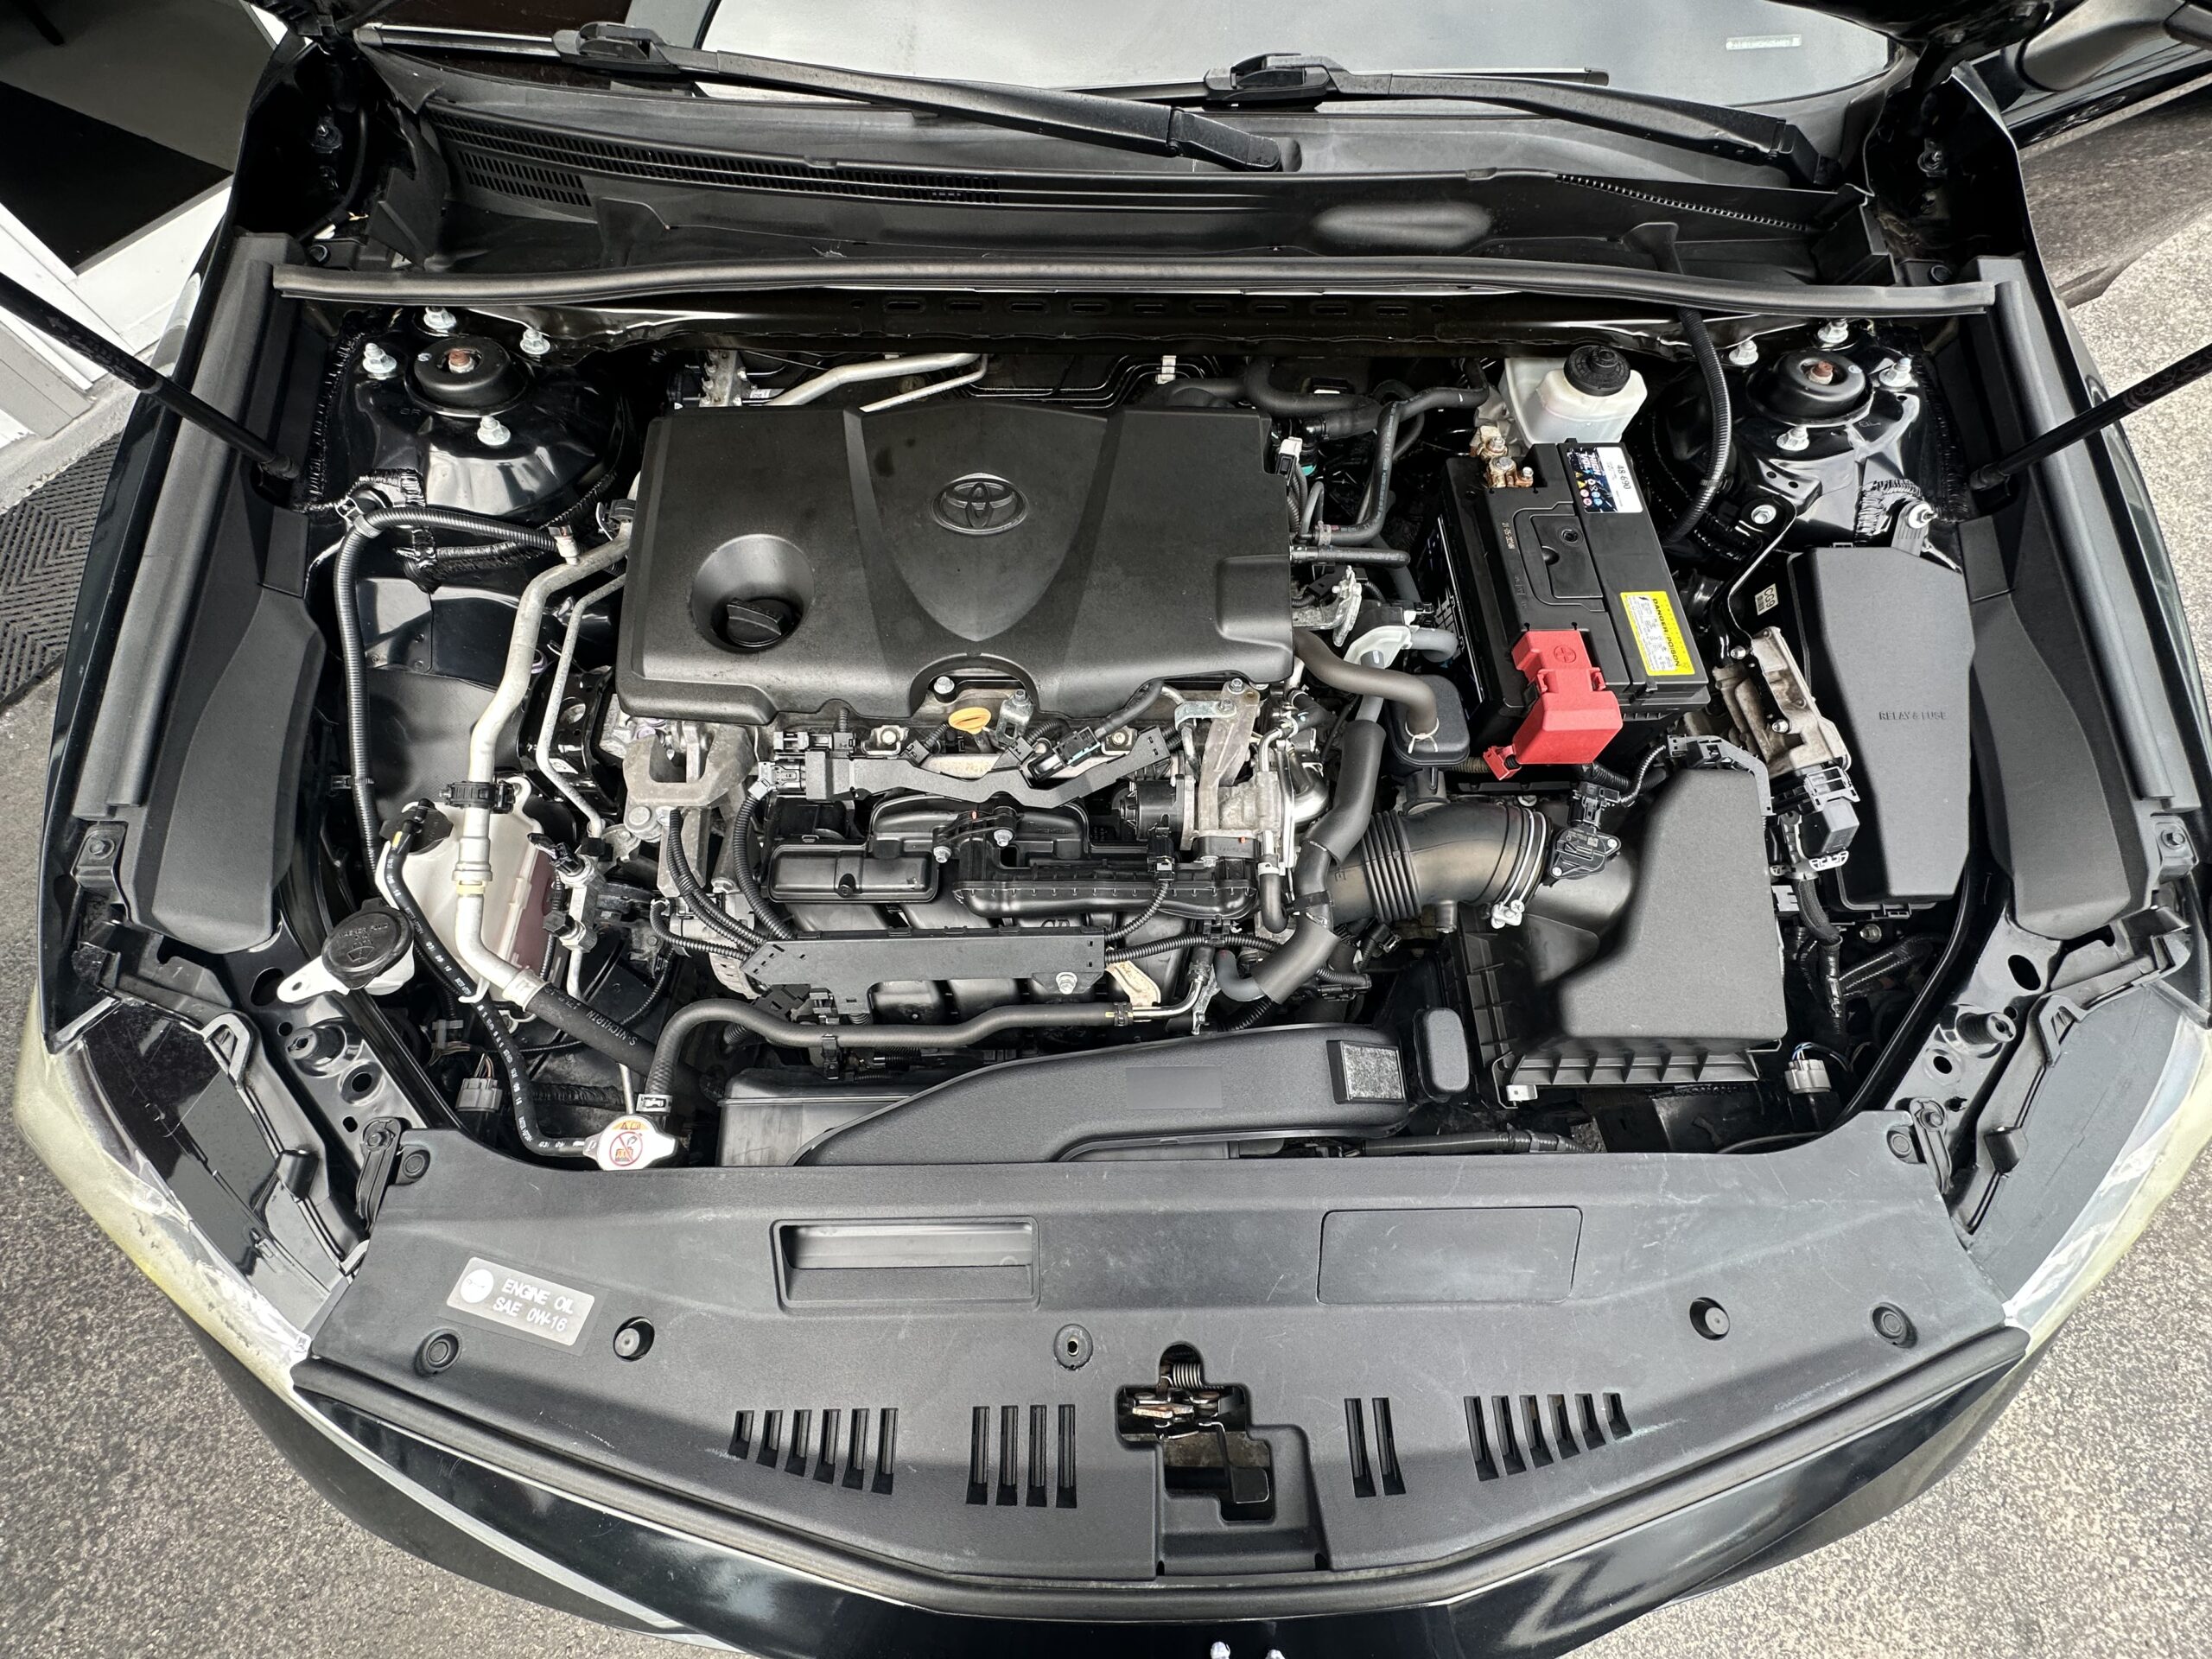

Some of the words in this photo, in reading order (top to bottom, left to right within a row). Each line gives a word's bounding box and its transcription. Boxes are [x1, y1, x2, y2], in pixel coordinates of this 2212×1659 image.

[1617, 465, 1631, 490] 48-690
[1764, 588, 1776, 607] CG9
[1878, 711, 1910, 721] RELAY
[501, 1278, 551, 1306] ENGINE
[554, 1295, 574, 1315] OIL
[493, 1296, 523, 1318] SAE
[526, 1307, 568, 1332] 0W-16
